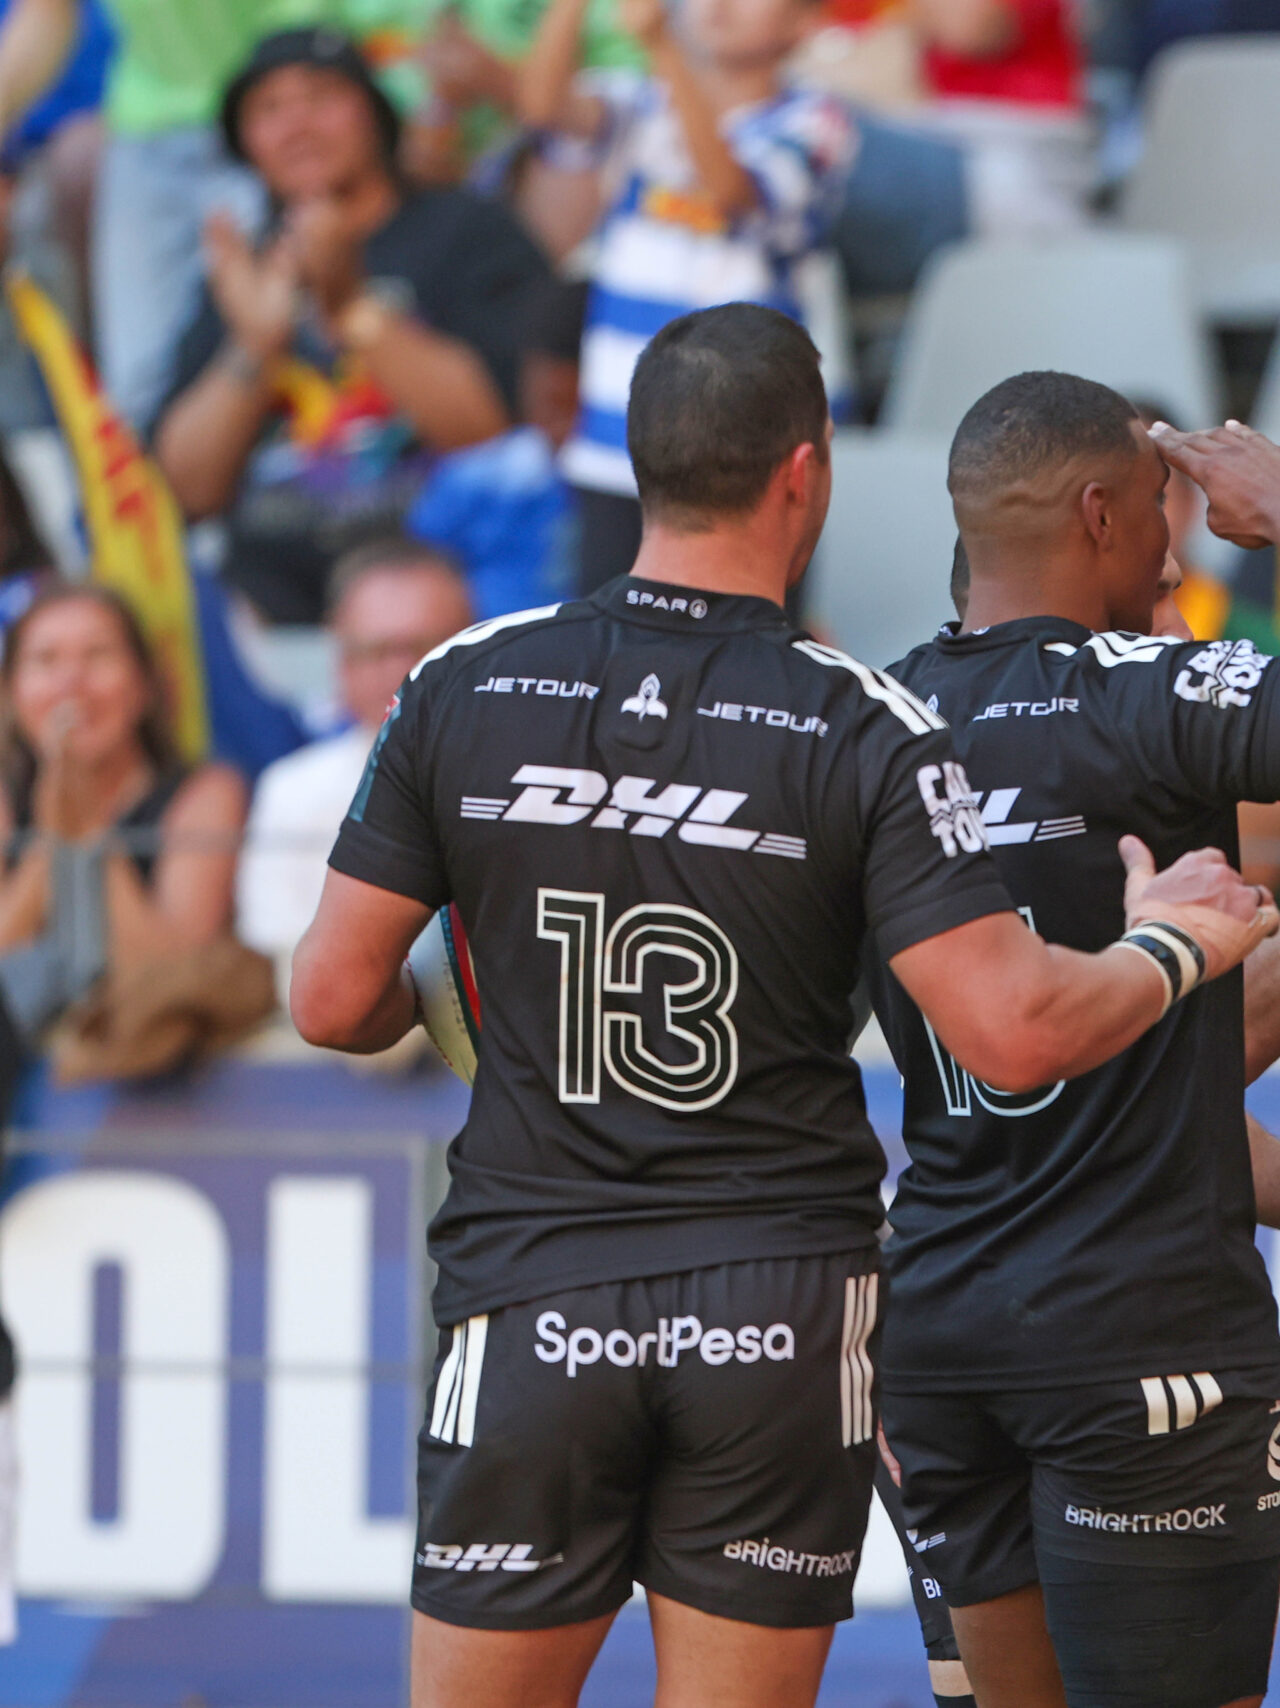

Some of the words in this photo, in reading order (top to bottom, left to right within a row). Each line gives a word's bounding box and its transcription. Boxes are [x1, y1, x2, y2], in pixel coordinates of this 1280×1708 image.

[625, 589, 689, 613] SPAR
[473, 676, 600, 700] JETOUR
[696, 701, 829, 737] JETOUR
[501, 763, 761, 852] DHL
[536, 888, 739, 1113] 13
[533, 1310, 797, 1378] SportPesa
[423, 1542, 541, 1573] DHL
